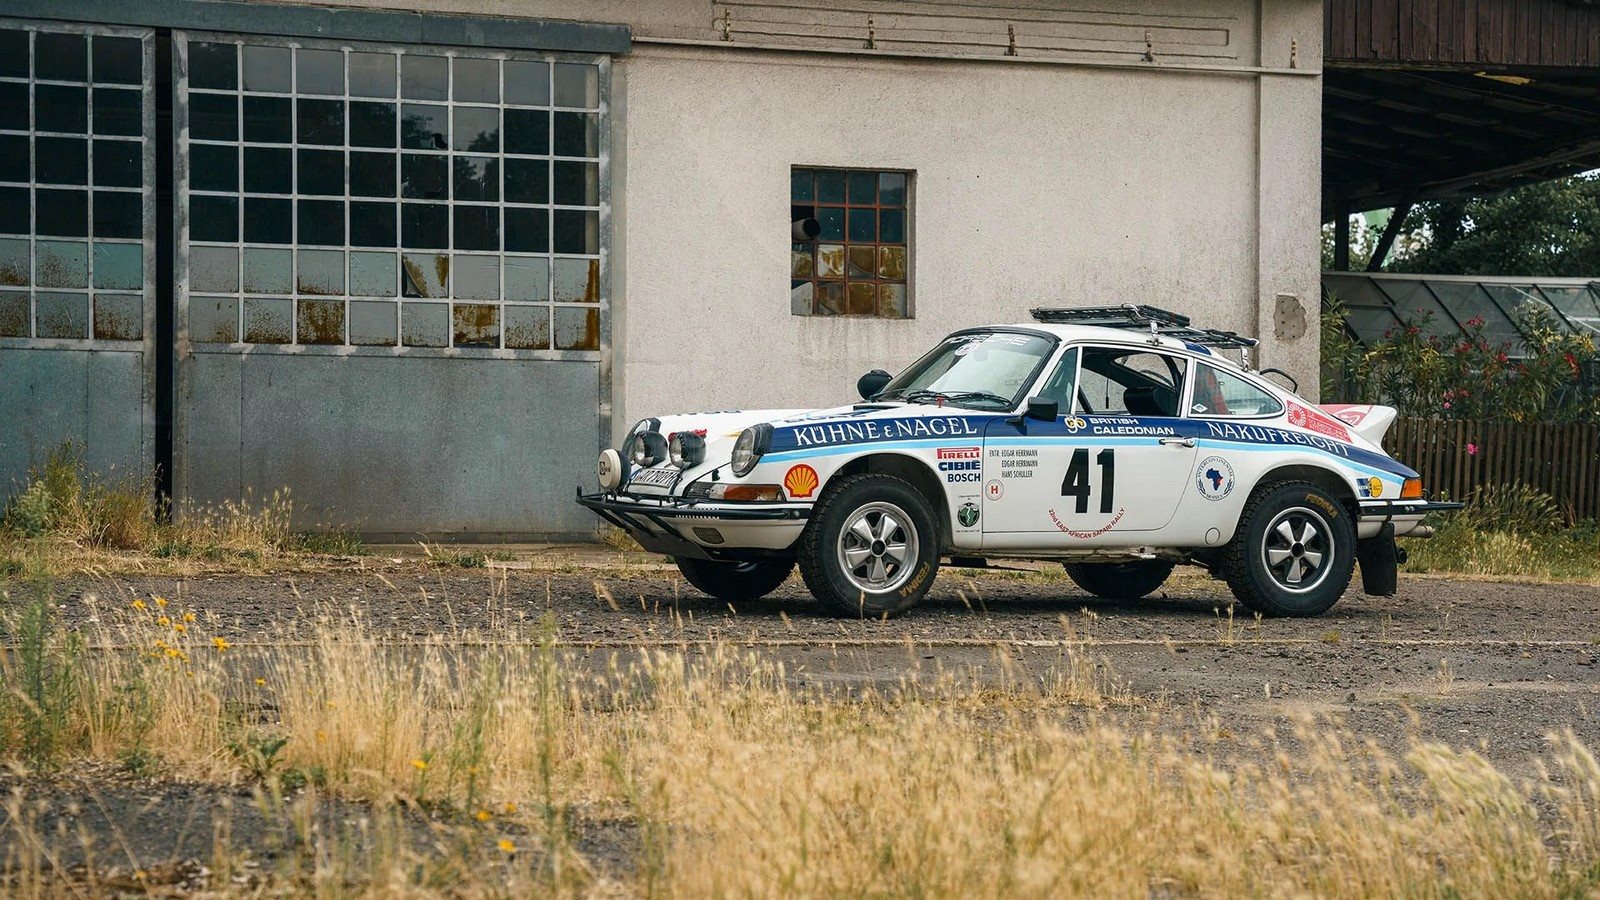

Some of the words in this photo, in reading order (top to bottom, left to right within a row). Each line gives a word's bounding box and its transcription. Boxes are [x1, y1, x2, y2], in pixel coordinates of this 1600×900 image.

[1088, 417, 1139, 425] BRITISH
[793, 420, 880, 446] KÜHNE
[894, 417, 977, 437] NAGEL
[1094, 426, 1174, 435] CALEDONIAN
[1206, 421, 1351, 457] NAKUFREIGHT
[937, 447, 980, 459] PIRELLI
[1001, 449, 1015, 457] EDGAR
[1001, 460, 1015, 468] EDGAR
[947, 473, 981, 483] BOSCH
[1001, 470, 1012, 478] HANS
[1061, 448, 1115, 513] 41
[991, 485, 999, 494] H
[1048, 508, 1058, 523] 22nd
[1056, 520, 1070, 533] EAST
[1068, 530, 1092, 539] AFRICAN
[1092, 523, 1112, 538] SAFARI
[1111, 507, 1125, 526] RALLY
